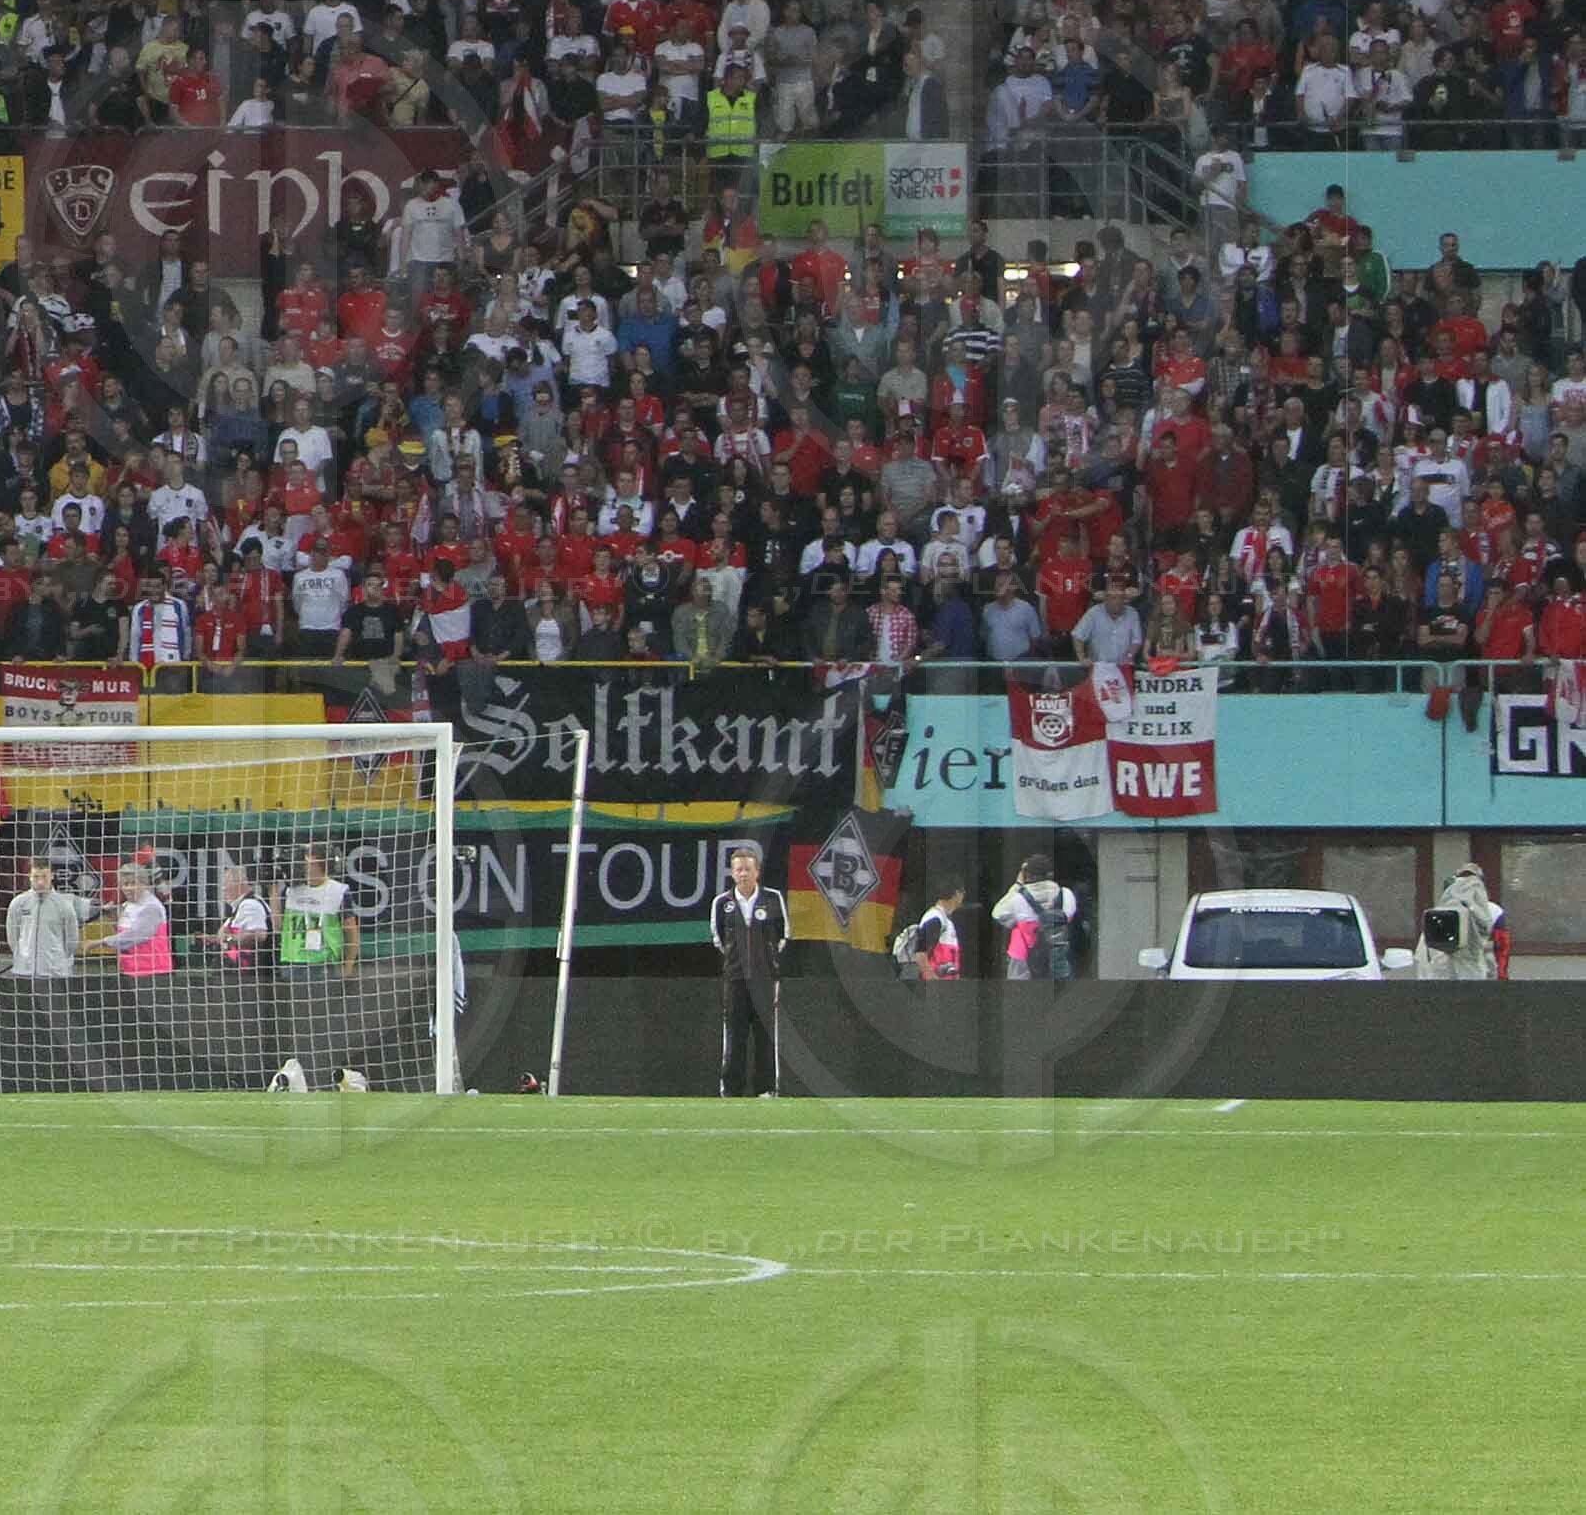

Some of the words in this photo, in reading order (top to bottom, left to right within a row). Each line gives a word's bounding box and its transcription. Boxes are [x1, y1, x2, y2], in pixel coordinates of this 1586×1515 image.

[890, 167, 945, 185] SPORT
[772, 171, 873, 207] Buffet
[3, 672, 58, 693] BRUCK
[92, 680, 132, 693] MUR
[1134, 676, 1203, 694] ANDRA
[4, 705, 52, 722] BOYS
[89, 711, 133, 724] TOUR
[1145, 701, 1176, 715] und
[1127, 721, 1193, 736] FELIX
[1115, 759, 1202, 798] RWE
